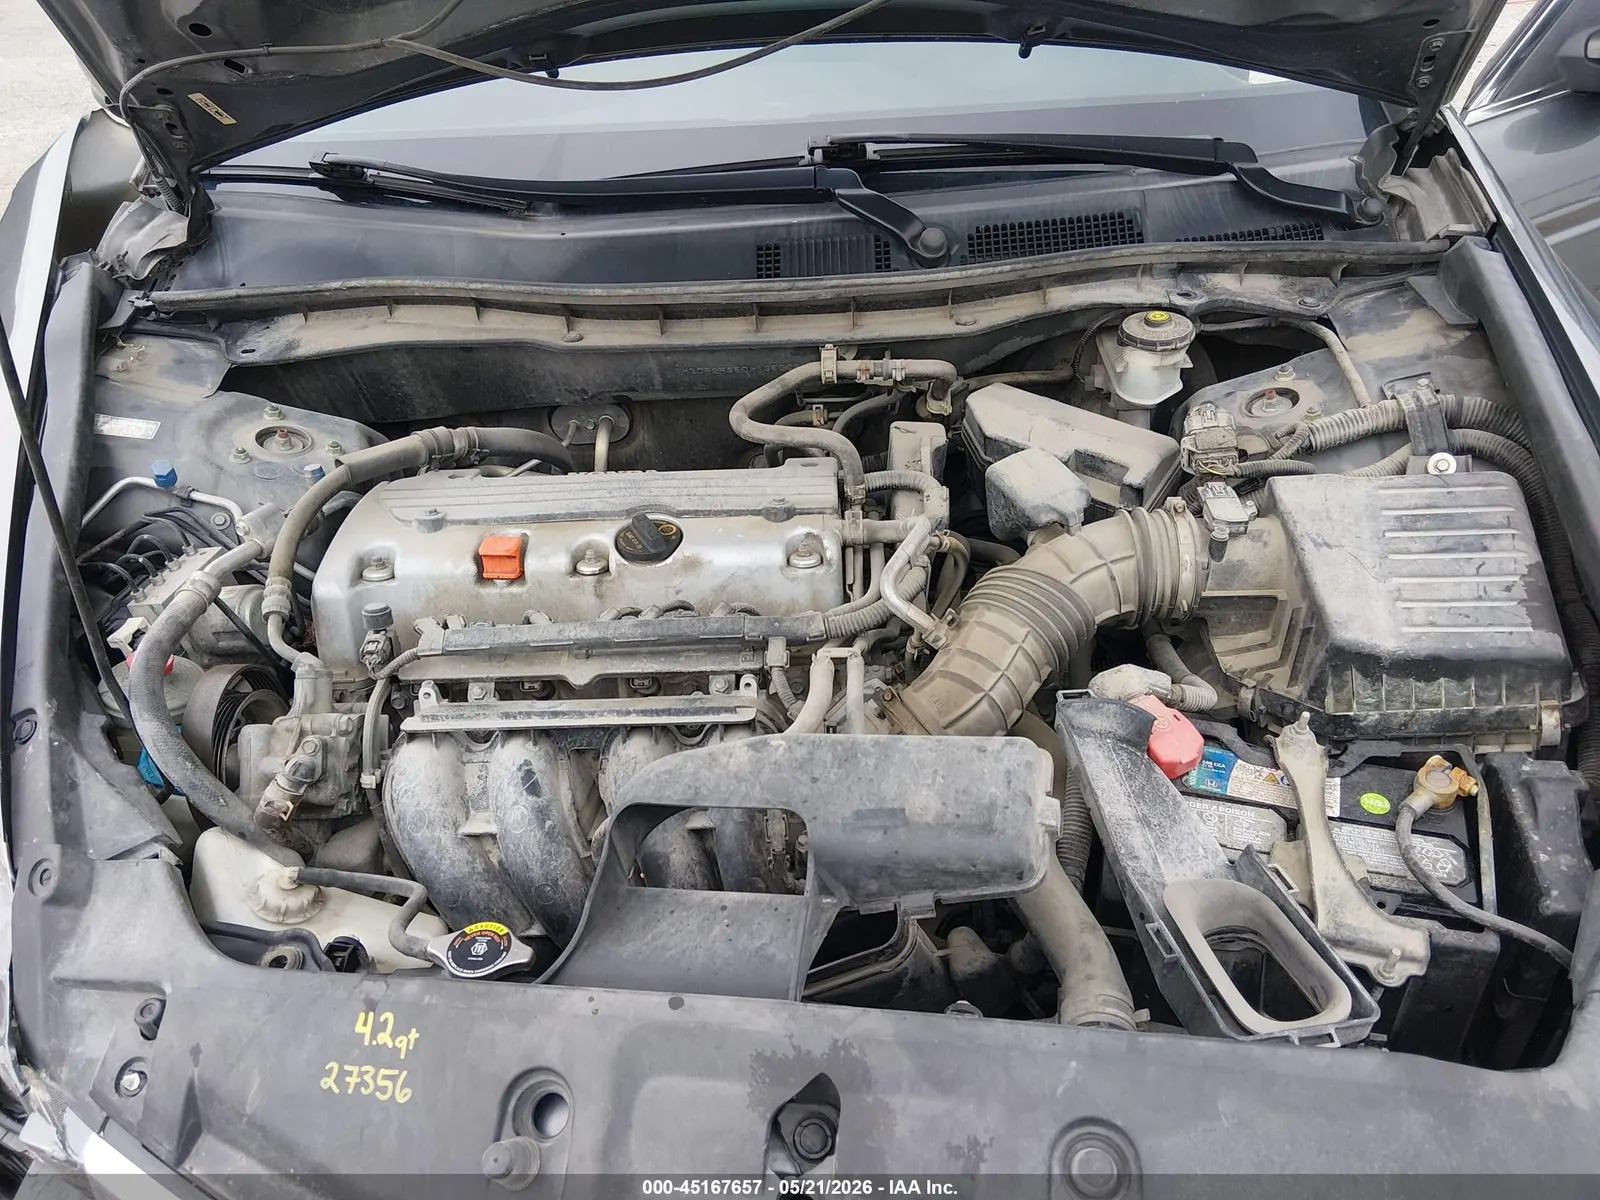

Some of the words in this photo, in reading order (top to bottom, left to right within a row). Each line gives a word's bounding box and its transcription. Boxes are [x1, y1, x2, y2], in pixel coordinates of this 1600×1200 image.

[1187, 800, 1209, 810] GER
[1218, 807, 1255, 818] POISON
[354, 1011, 420, 1060] 4.2qt
[320, 1061, 413, 1104] 27356
